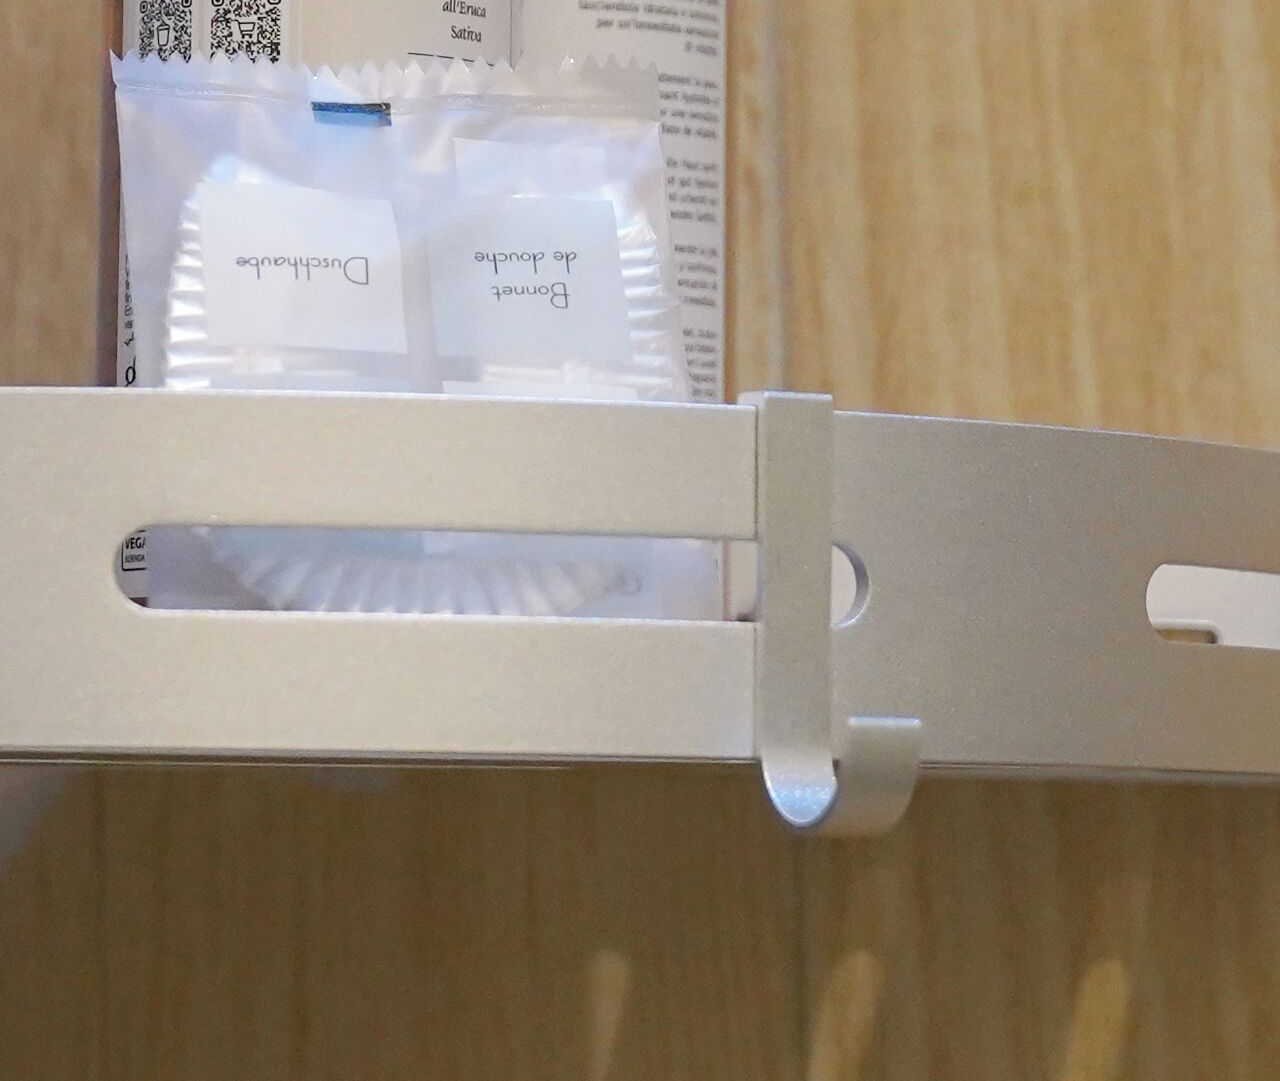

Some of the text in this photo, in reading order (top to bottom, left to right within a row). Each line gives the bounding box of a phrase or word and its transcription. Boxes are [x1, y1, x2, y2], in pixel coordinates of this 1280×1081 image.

[450, 24, 483, 44] Sativa
[235, 256, 370, 286] Duschhaube
[473, 250, 577, 275] de douche
[492, 281, 570, 309] Bonnet
